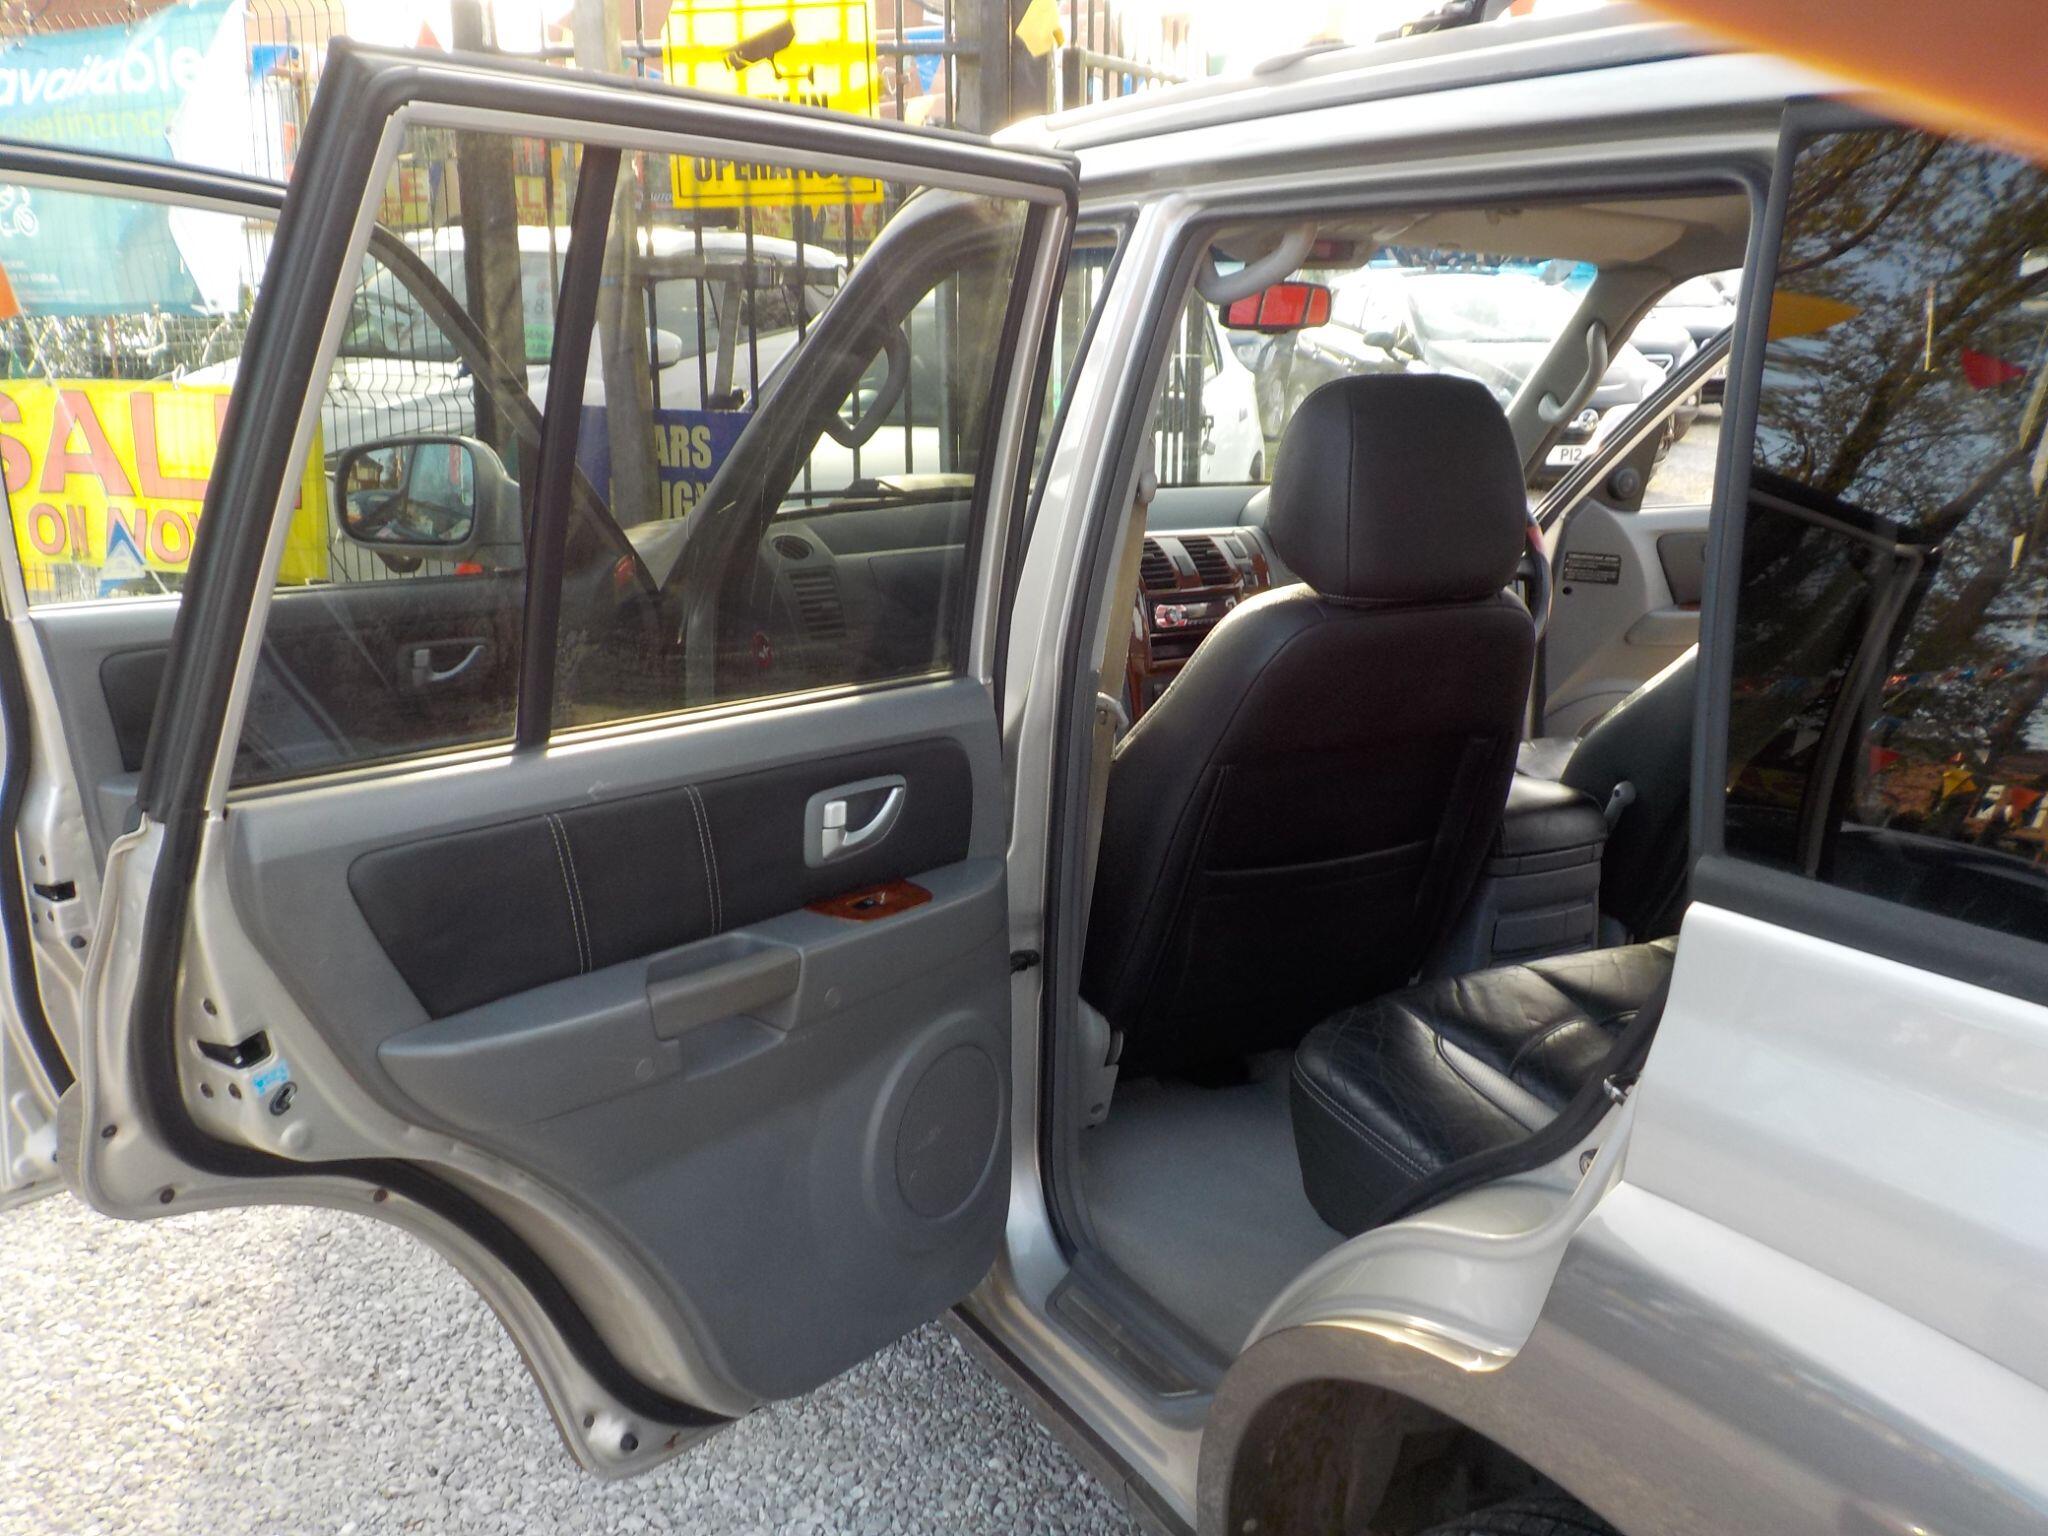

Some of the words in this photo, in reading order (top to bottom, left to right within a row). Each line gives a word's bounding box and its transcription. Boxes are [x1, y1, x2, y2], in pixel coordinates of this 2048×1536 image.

[0, 36, 201, 106] available
[694, 157, 842, 182] OPERA
[654, 424, 712, 469] ARS
[28, 503, 90, 559] ON
[106, 507, 203, 564] NO
